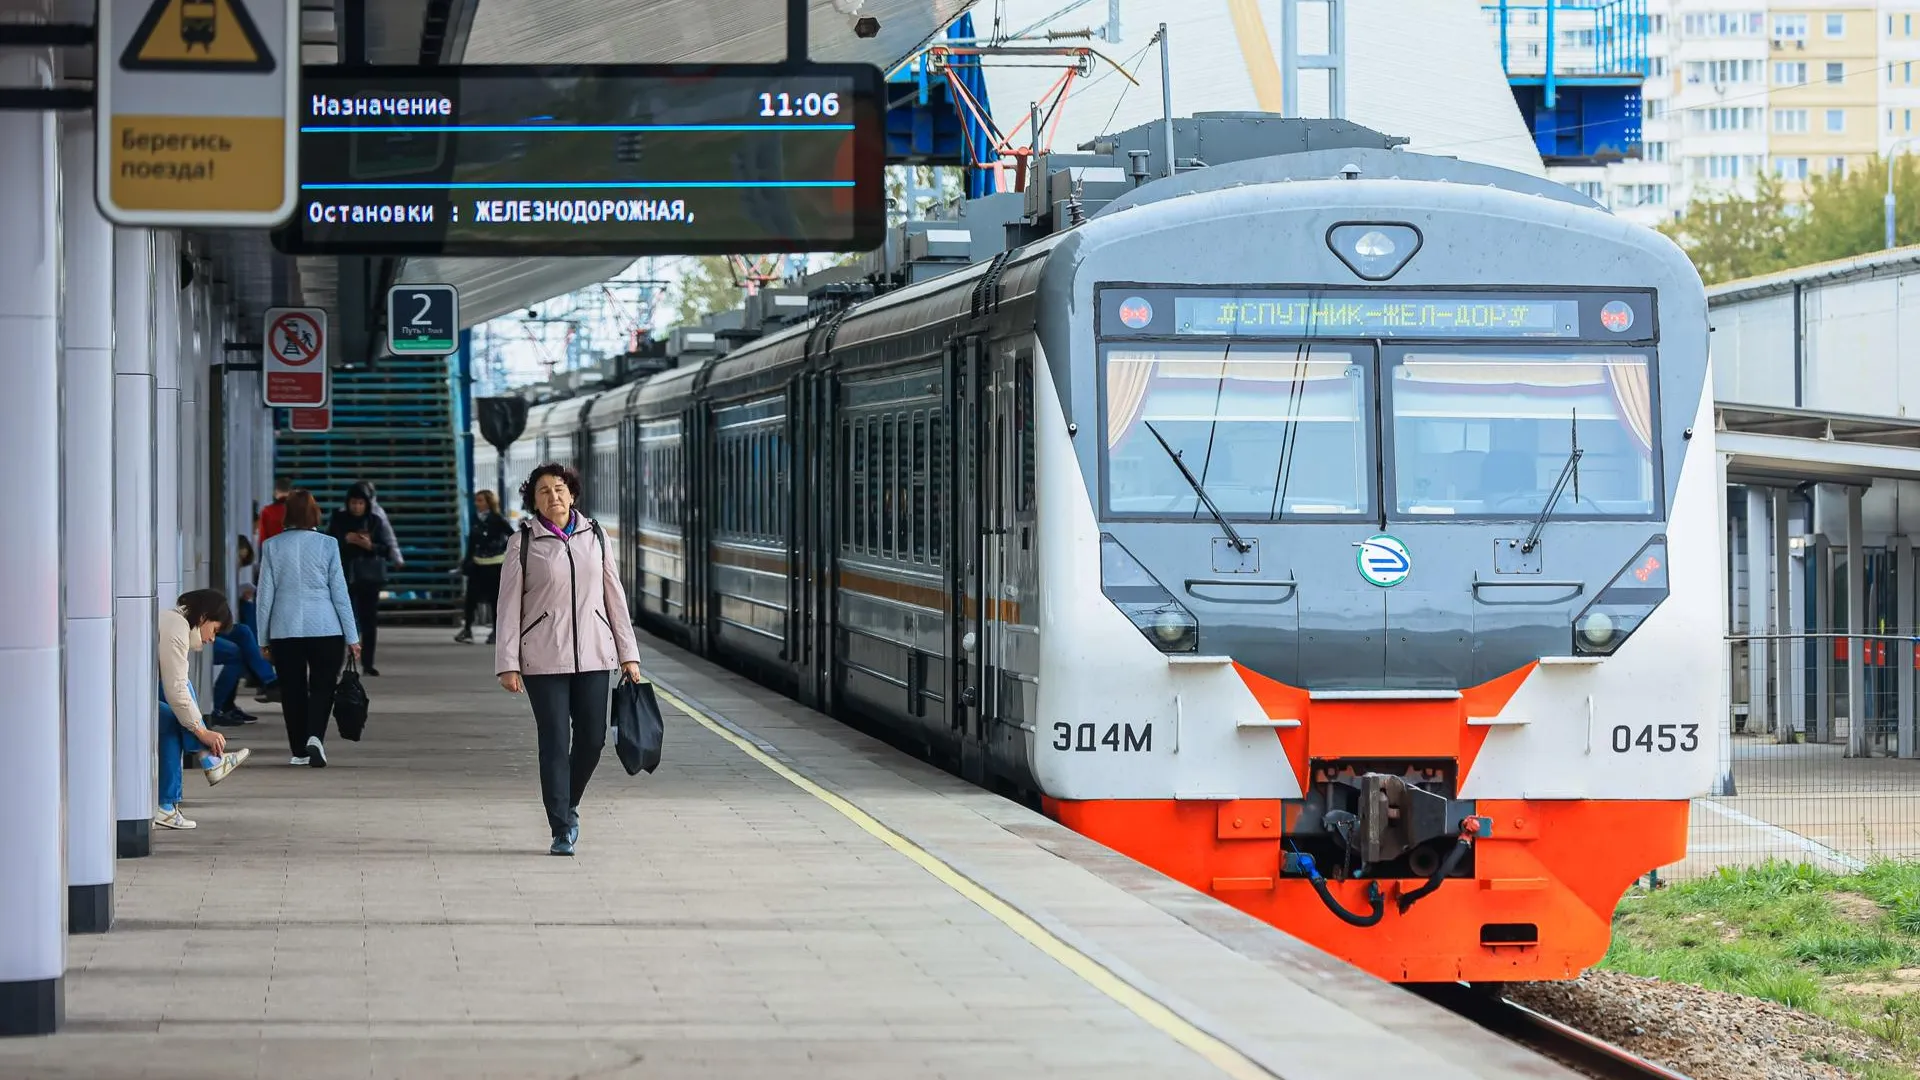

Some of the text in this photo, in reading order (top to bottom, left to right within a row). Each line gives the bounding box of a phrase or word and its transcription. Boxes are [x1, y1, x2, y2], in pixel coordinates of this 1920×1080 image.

[312, 94, 452, 116] Назначение
[758, 92, 840, 117] 11:06
[121, 127, 232, 155] Берегись
[120, 158, 214, 182] поезда!
[309, 201, 434, 223] Остановки
[475, 200, 695, 224] ЖЕЛЕЗНОДОРОЖНАЯ,
[411, 293, 432, 325] 2
[1052, 721, 1152, 752] ЭД4М
[1612, 723, 1699, 753] 0453
